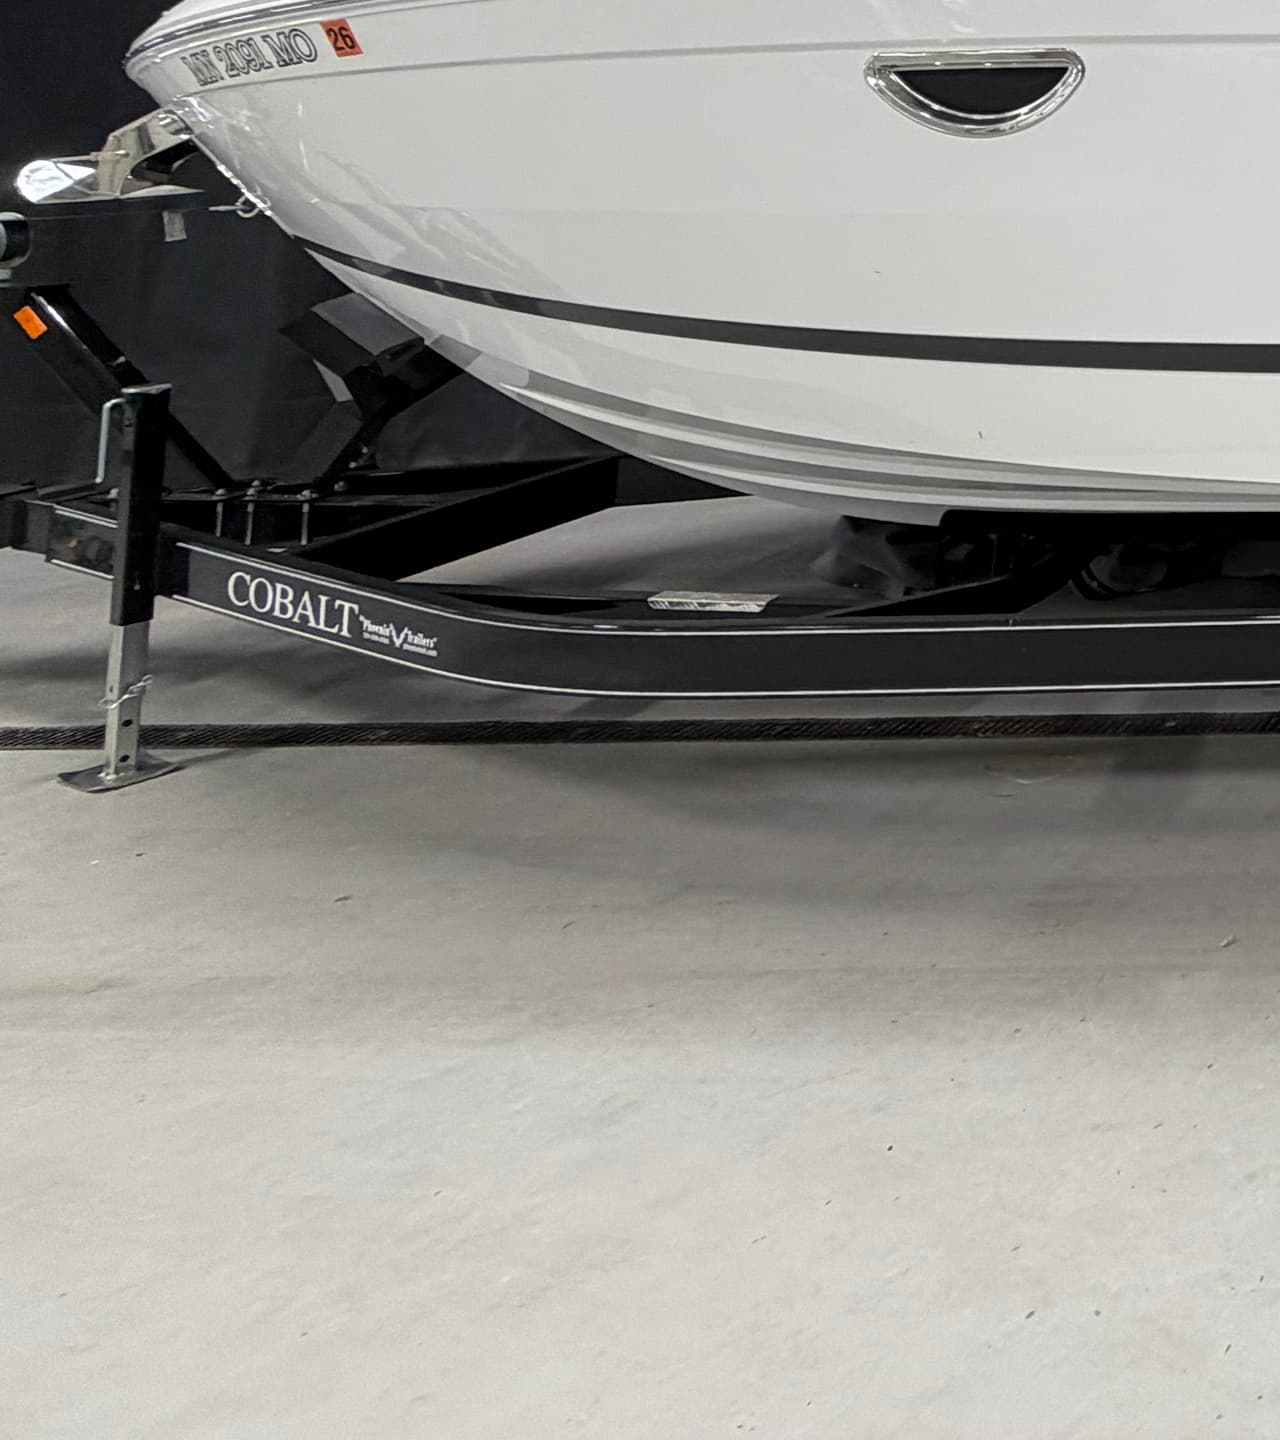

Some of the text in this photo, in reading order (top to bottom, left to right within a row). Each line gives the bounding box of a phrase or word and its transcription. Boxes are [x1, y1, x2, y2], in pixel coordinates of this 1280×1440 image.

[213, 37, 275, 79] 2091
[260, 28, 318, 68] MO
[326, 26, 355, 51] 26
[228, 571, 359, 638] COBALT
